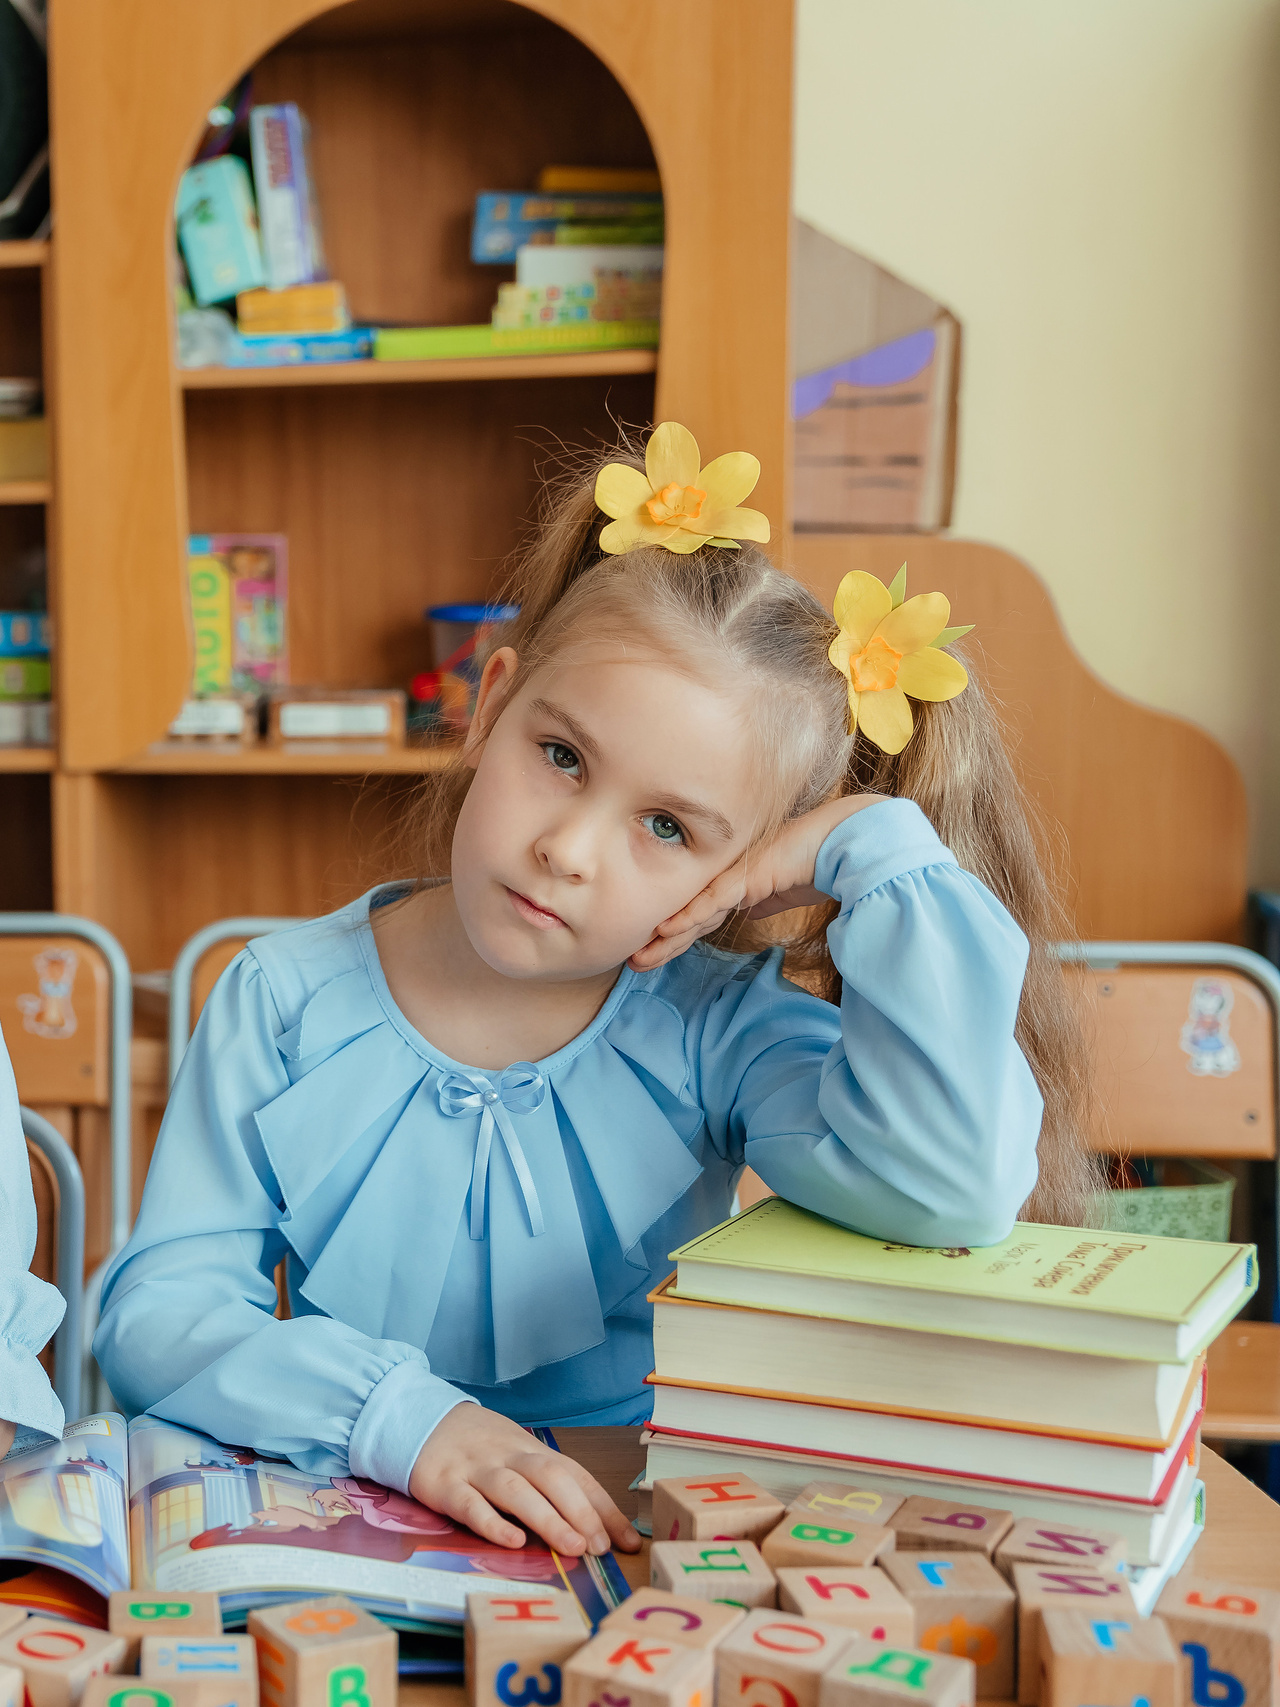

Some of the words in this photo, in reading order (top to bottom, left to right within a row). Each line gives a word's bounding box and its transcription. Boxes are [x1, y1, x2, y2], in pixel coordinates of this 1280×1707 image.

[1066, 1241, 1109, 1260] Тома
[1031, 1259, 1086, 1289] Сойера
[1069, 1242, 1148, 1296] Приключения
[685, 1481, 757, 1503] Н
[490, 1599, 560, 1622] Н
[16, 1631, 86, 1661] О
[752, 1622, 826, 1654] О
[607, 1639, 671, 1674] К
